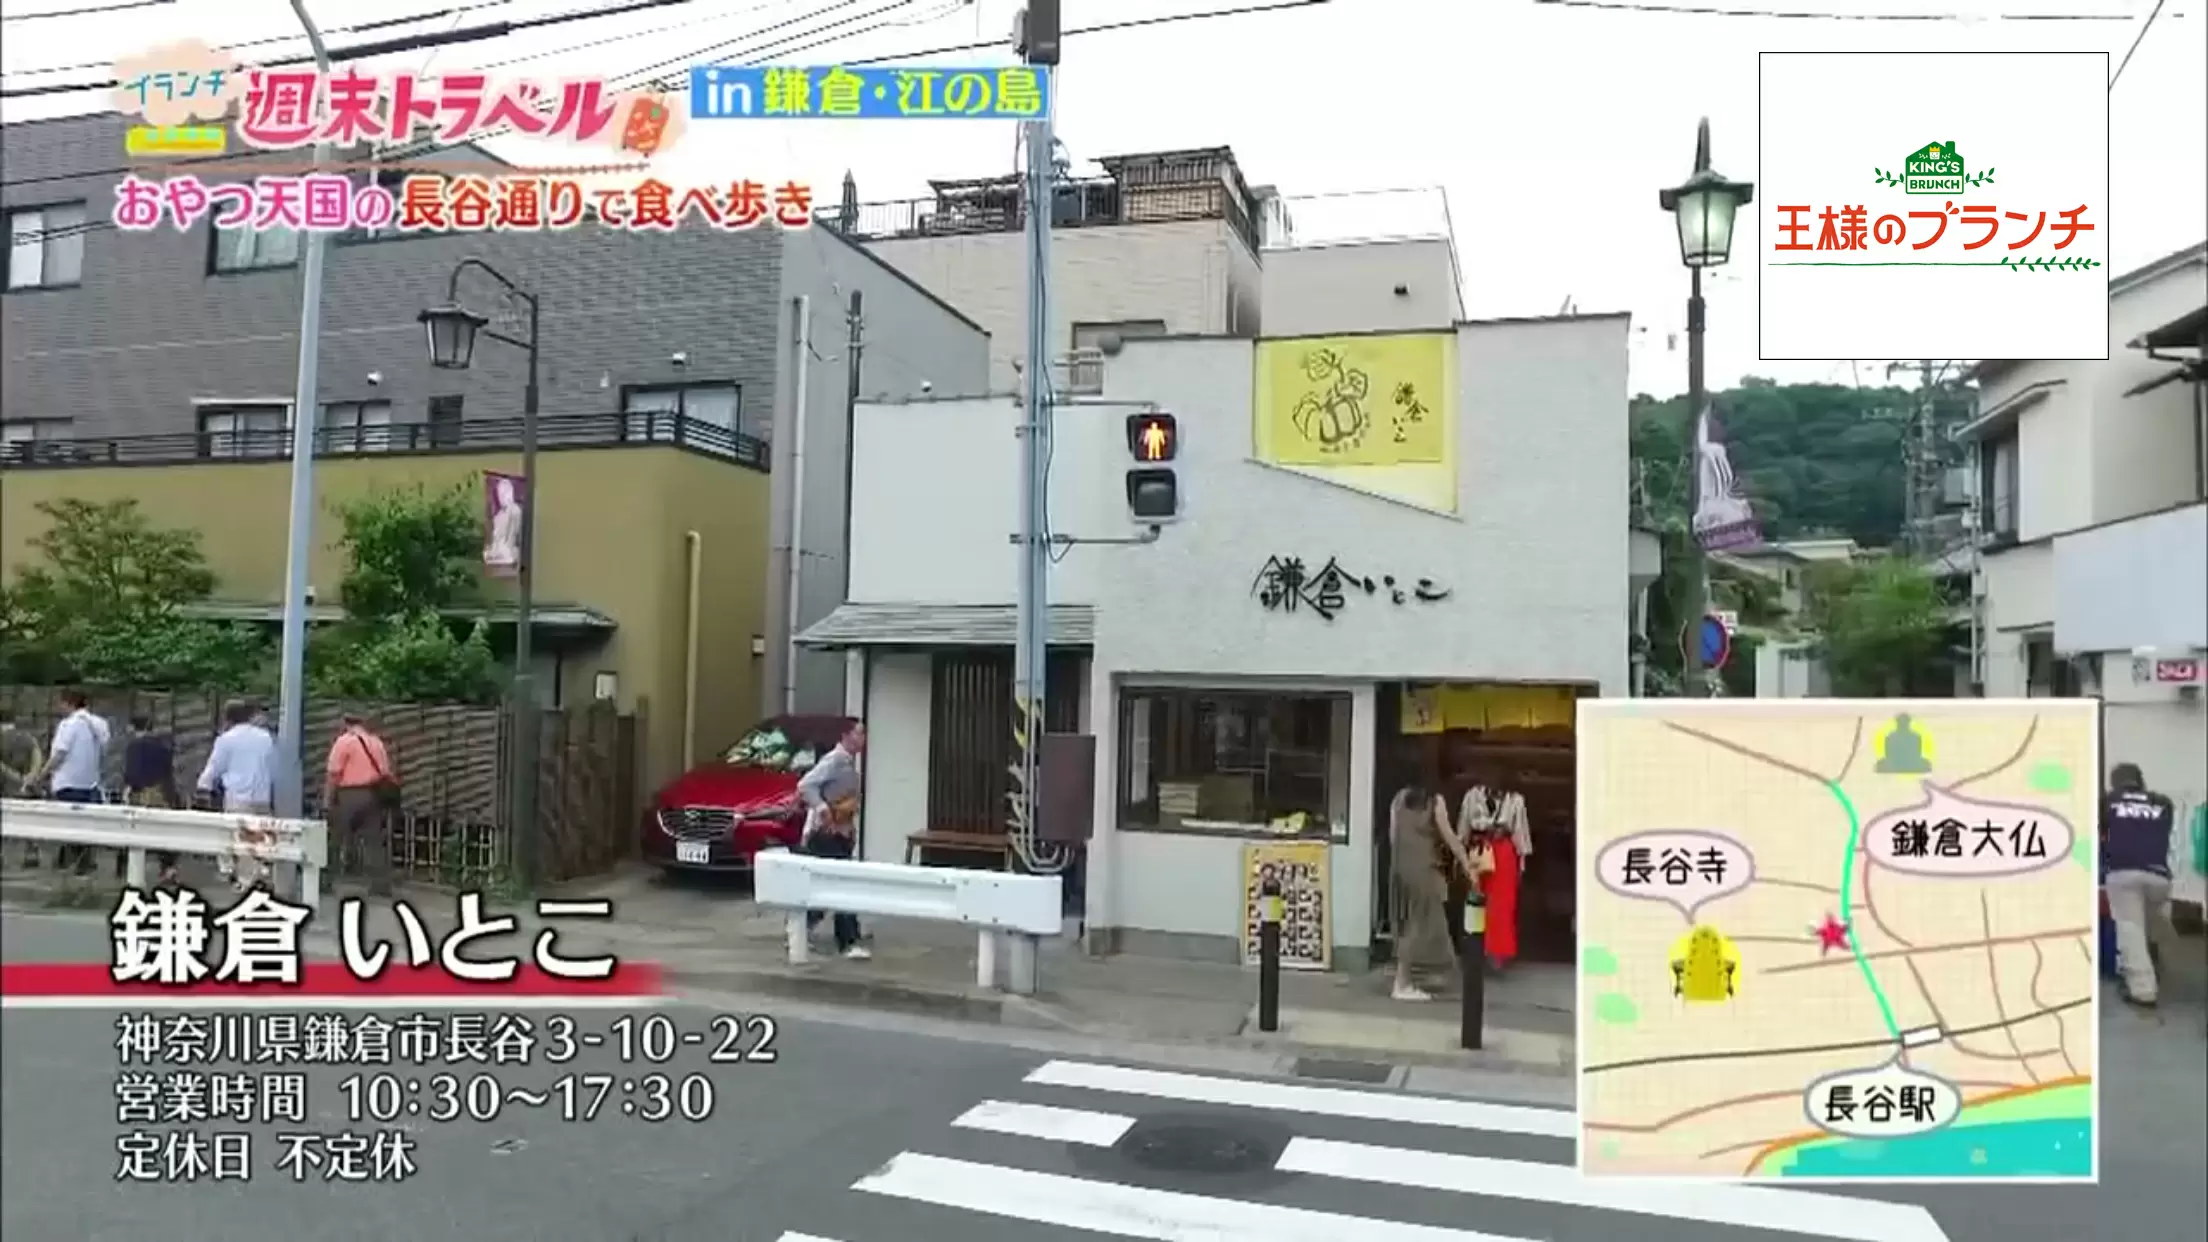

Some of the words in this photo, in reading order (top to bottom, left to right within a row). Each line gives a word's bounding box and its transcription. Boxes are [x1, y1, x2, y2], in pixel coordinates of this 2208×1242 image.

[1251, 554, 1452, 621] 鎌倉いとこ
